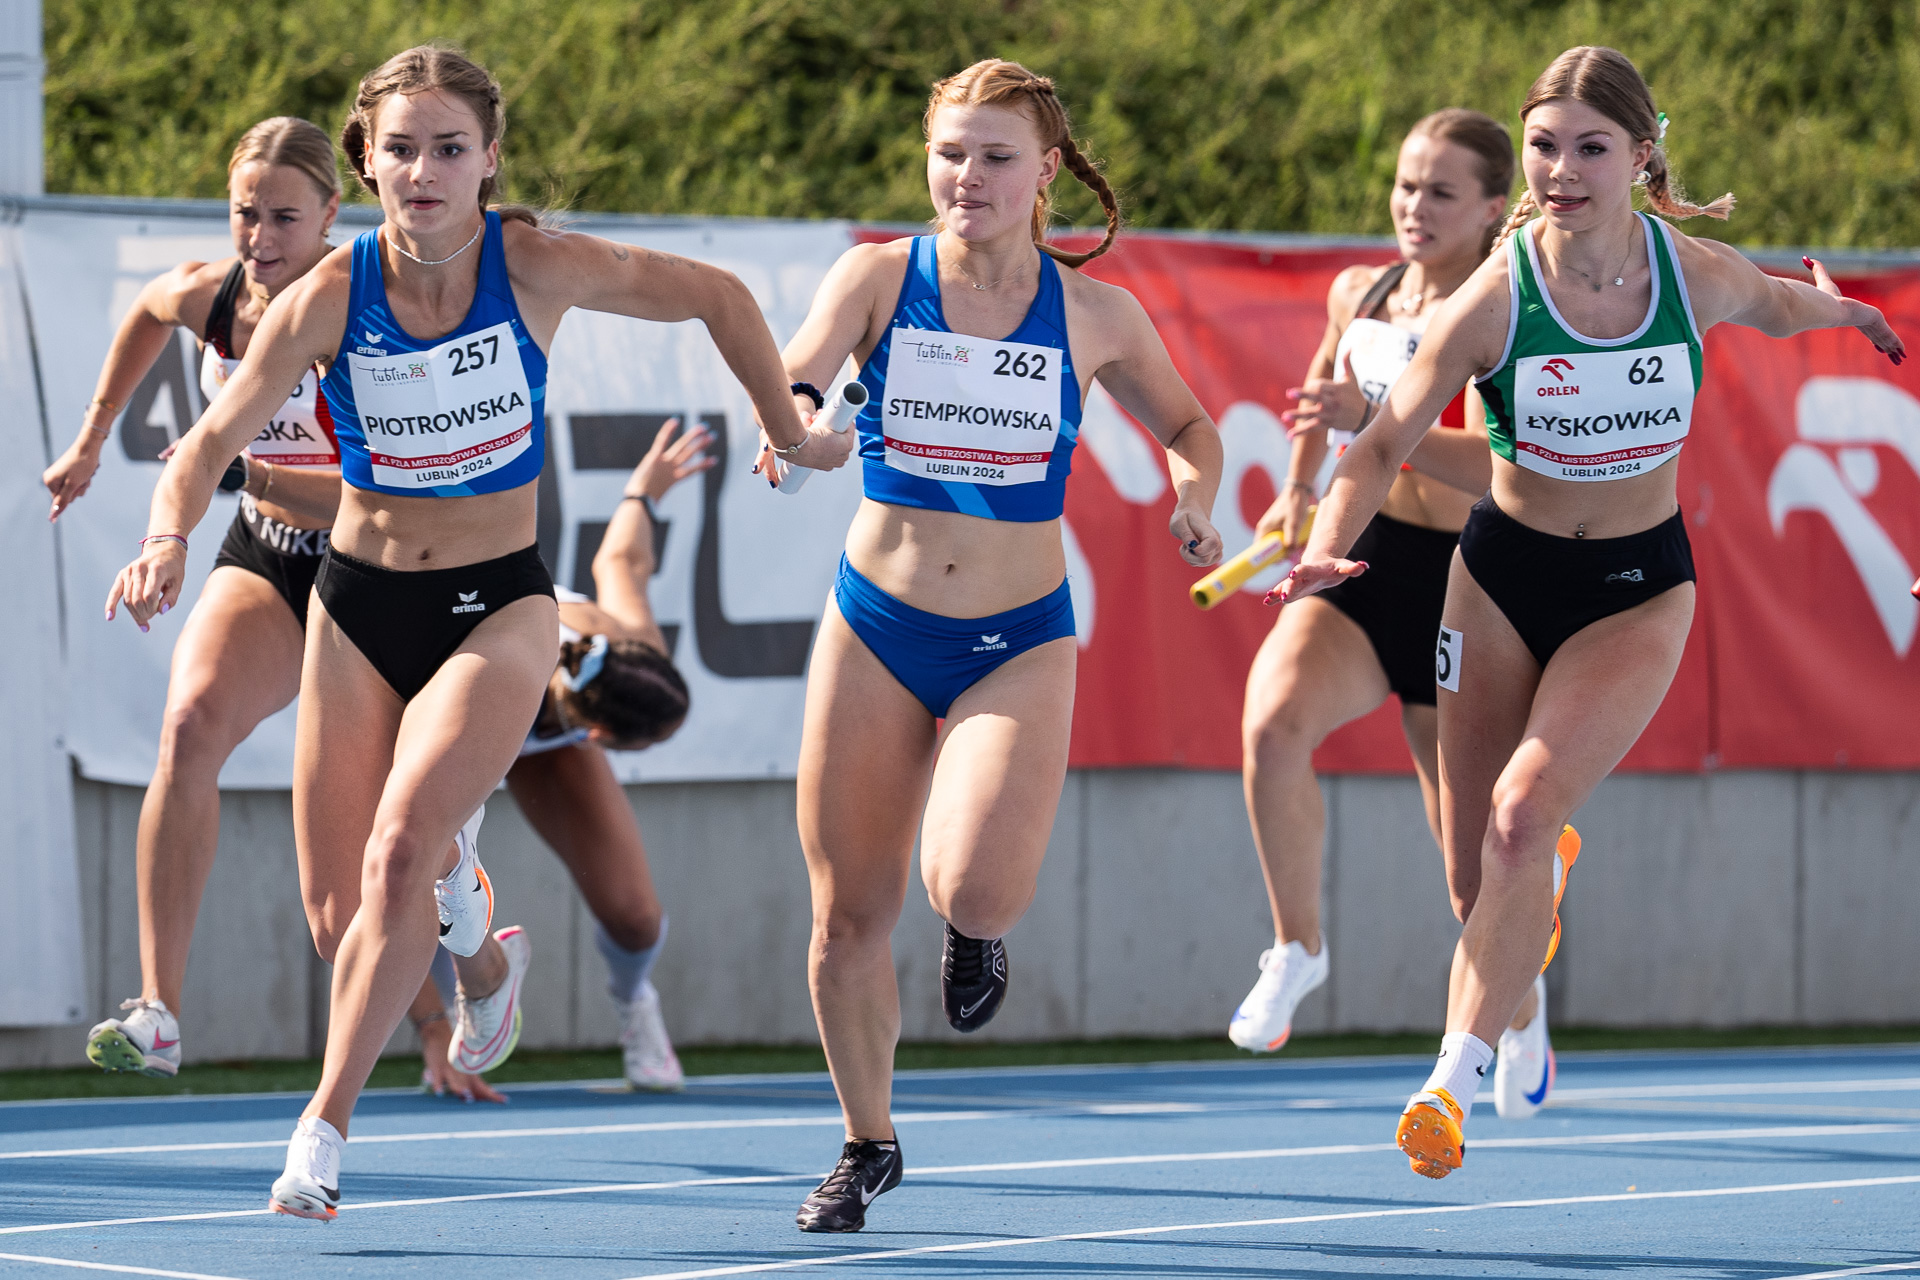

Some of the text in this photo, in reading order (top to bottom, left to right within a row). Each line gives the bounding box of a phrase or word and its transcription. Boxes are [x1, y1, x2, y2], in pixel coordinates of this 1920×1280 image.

[357, 345, 387, 357] erima
[448, 335, 499, 376] 257
[909, 341, 952, 360] lublin
[365, 367, 409, 382] lublin
[993, 349, 1047, 381] 262
[1628, 356, 1665, 385] 62
[1537, 385, 1580, 397] ORLEN
[365, 391, 525, 436] PIOTROWSKA
[888, 398, 1053, 431] STEMPKOWSKA
[1526, 407, 1682, 437] ŁYSKOWKA
[391, 458, 410, 468] PZLA
[411, 449, 477, 468] MISTRZOSTWA
[478, 438, 510, 453] POLSKI
[510, 429, 526, 442] U23
[903, 444, 924, 455] PZLA
[925, 447, 993, 461] MISTRZOSTWA
[995, 454, 1024, 463] POLSKI
[1025, 454, 1043, 462] U23
[1526, 445, 1537, 454] 41.
[1539, 450, 1559, 461] PZLA
[1561, 452, 1628, 464] MISTRZOSTWA
[1630, 446, 1661, 457] POLSKI
[416, 457, 493, 482] LUBLIN 2024
[926, 463, 1005, 479] LUBLIN 2024
[1562, 462, 1641, 477] LUBLIN 2024
[260, 516, 331, 556] NIKE
[452, 603, 485, 614] erima
[972, 641, 1008, 652] erima
[1437, 629, 1451, 682] 5
